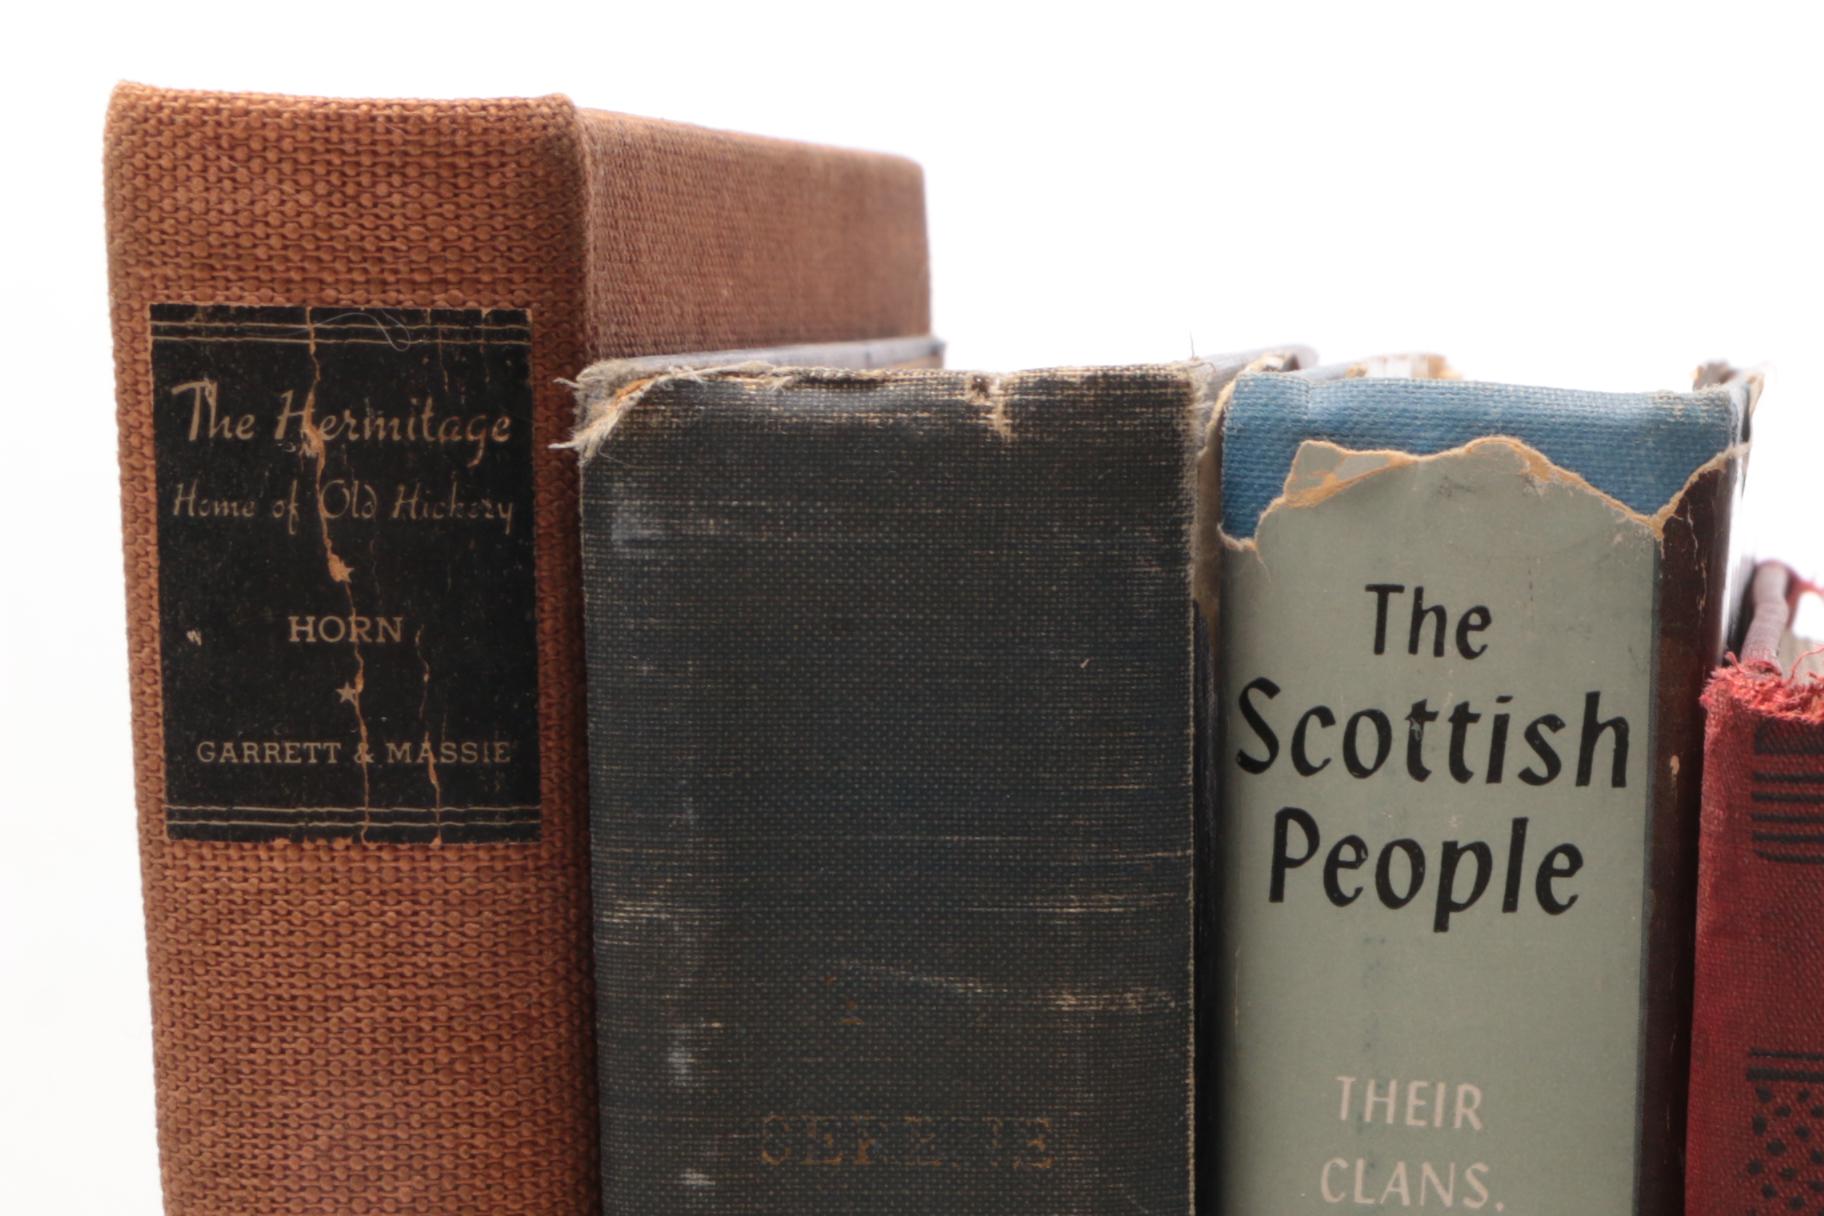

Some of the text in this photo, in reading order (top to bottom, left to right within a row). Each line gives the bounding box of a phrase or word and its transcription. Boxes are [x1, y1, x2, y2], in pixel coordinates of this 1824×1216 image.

[171, 377, 512, 468] The Hermitage
[272, 479, 300, 535] of
[319, 478, 377, 520] Old
[289, 615, 404, 644] HORN
[1364, 583, 1493, 660] The
[196, 740, 511, 765] GARRETT & MASSIE
[1235, 676, 1630, 789] Scottish
[1268, 807, 1585, 933] People
[1336, 1075, 1484, 1131] THEIR
